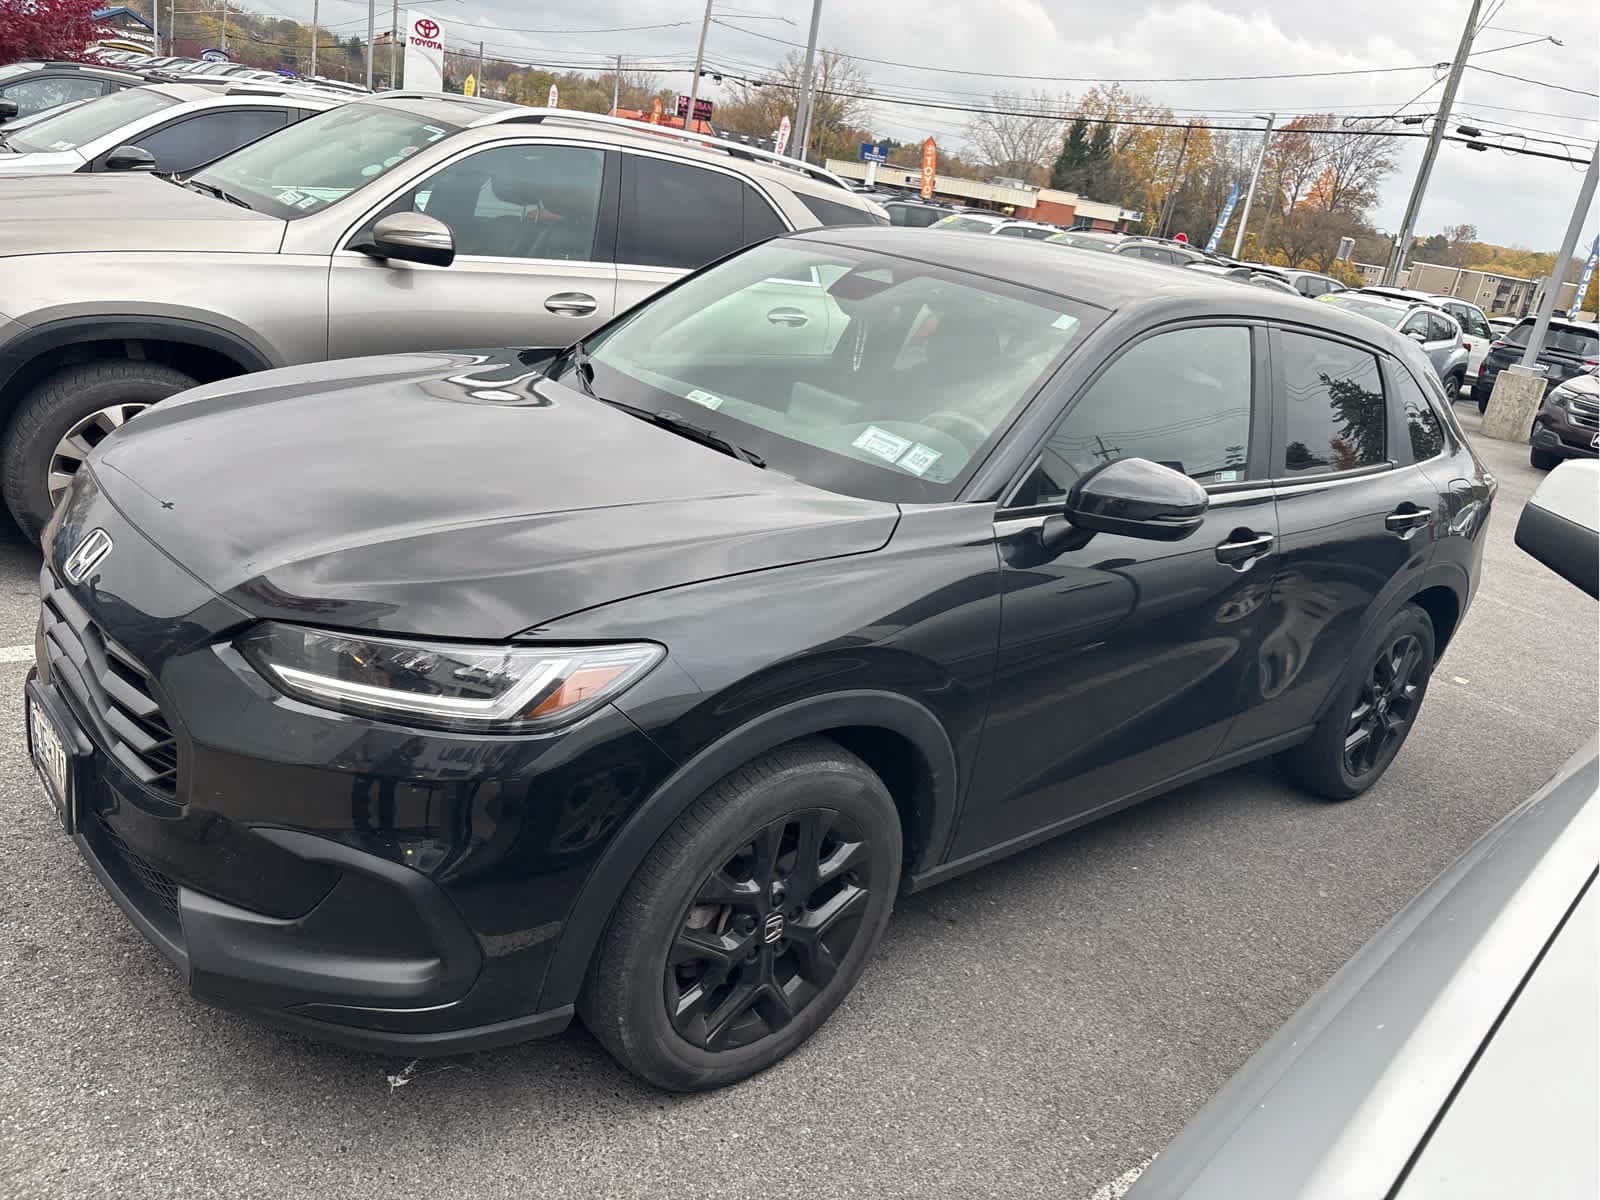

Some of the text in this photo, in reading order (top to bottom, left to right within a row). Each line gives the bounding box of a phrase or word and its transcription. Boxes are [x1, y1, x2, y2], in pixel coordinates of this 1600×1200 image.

[409, 36, 443, 50] TOYOTA
[922, 156, 934, 198] TOYO
[1205, 204, 1233, 253] SUBA
